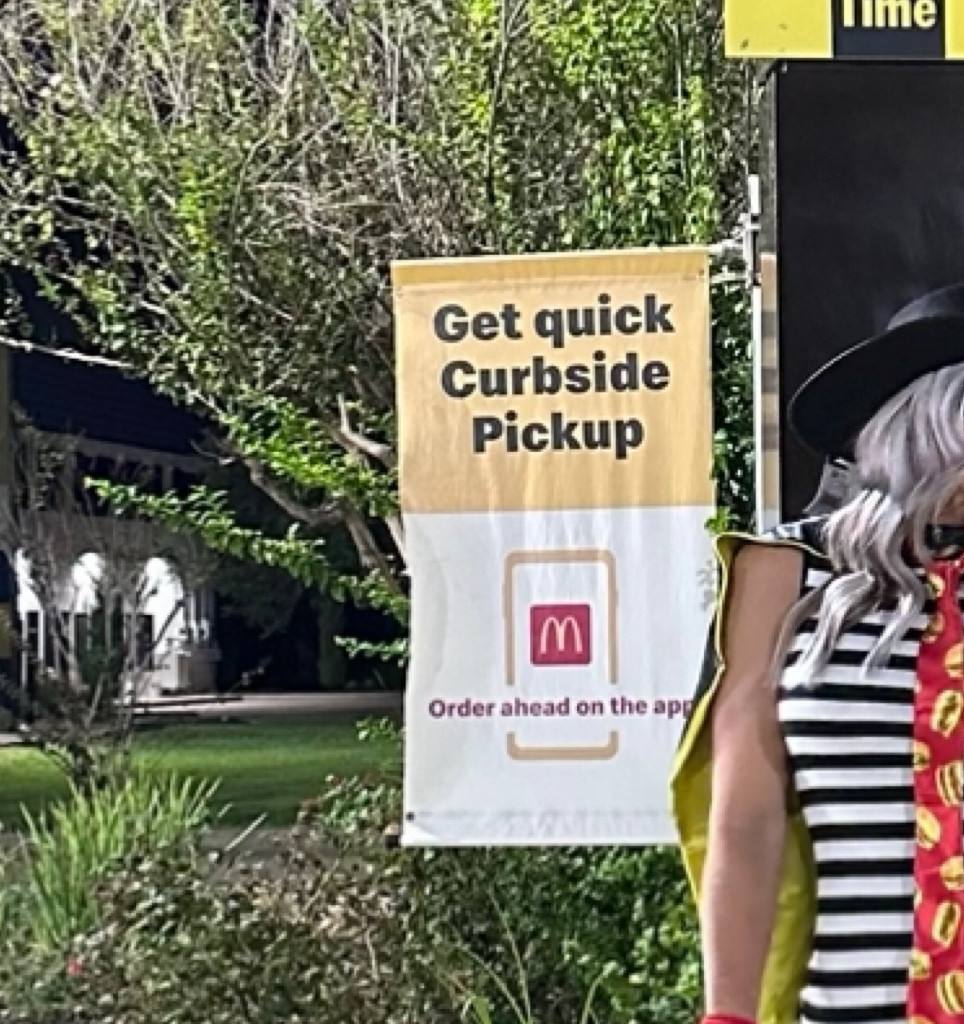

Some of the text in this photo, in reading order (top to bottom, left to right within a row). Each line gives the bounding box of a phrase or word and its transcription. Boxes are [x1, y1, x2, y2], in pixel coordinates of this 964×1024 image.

[433, 293, 674, 348] Get quick
[441, 350, 671, 398] Curbside
[472, 410, 644, 460] Pickup
[428, 698, 495, 718] Order
[500, 697, 570, 717] ahead
[576, 700, 604, 717] on
[610, 696, 648, 717] the
